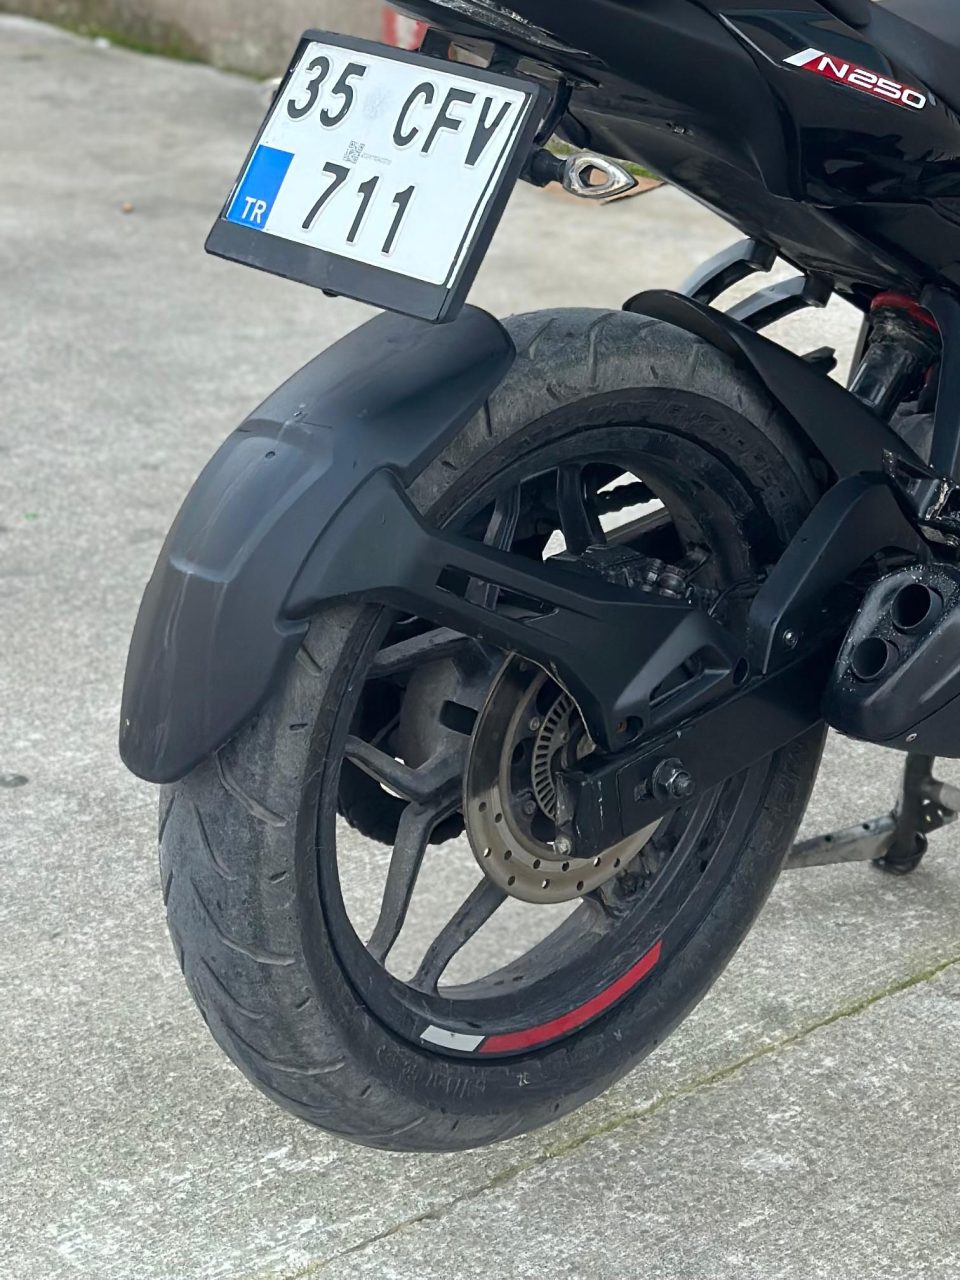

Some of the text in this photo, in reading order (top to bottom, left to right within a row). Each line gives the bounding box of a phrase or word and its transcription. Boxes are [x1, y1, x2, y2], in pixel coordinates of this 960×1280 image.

[286, 55, 513, 167] 35 CFV
[817, 56, 927, 110] N250
[243, 196, 266, 223] TR
[301, 161, 416, 254] 711
